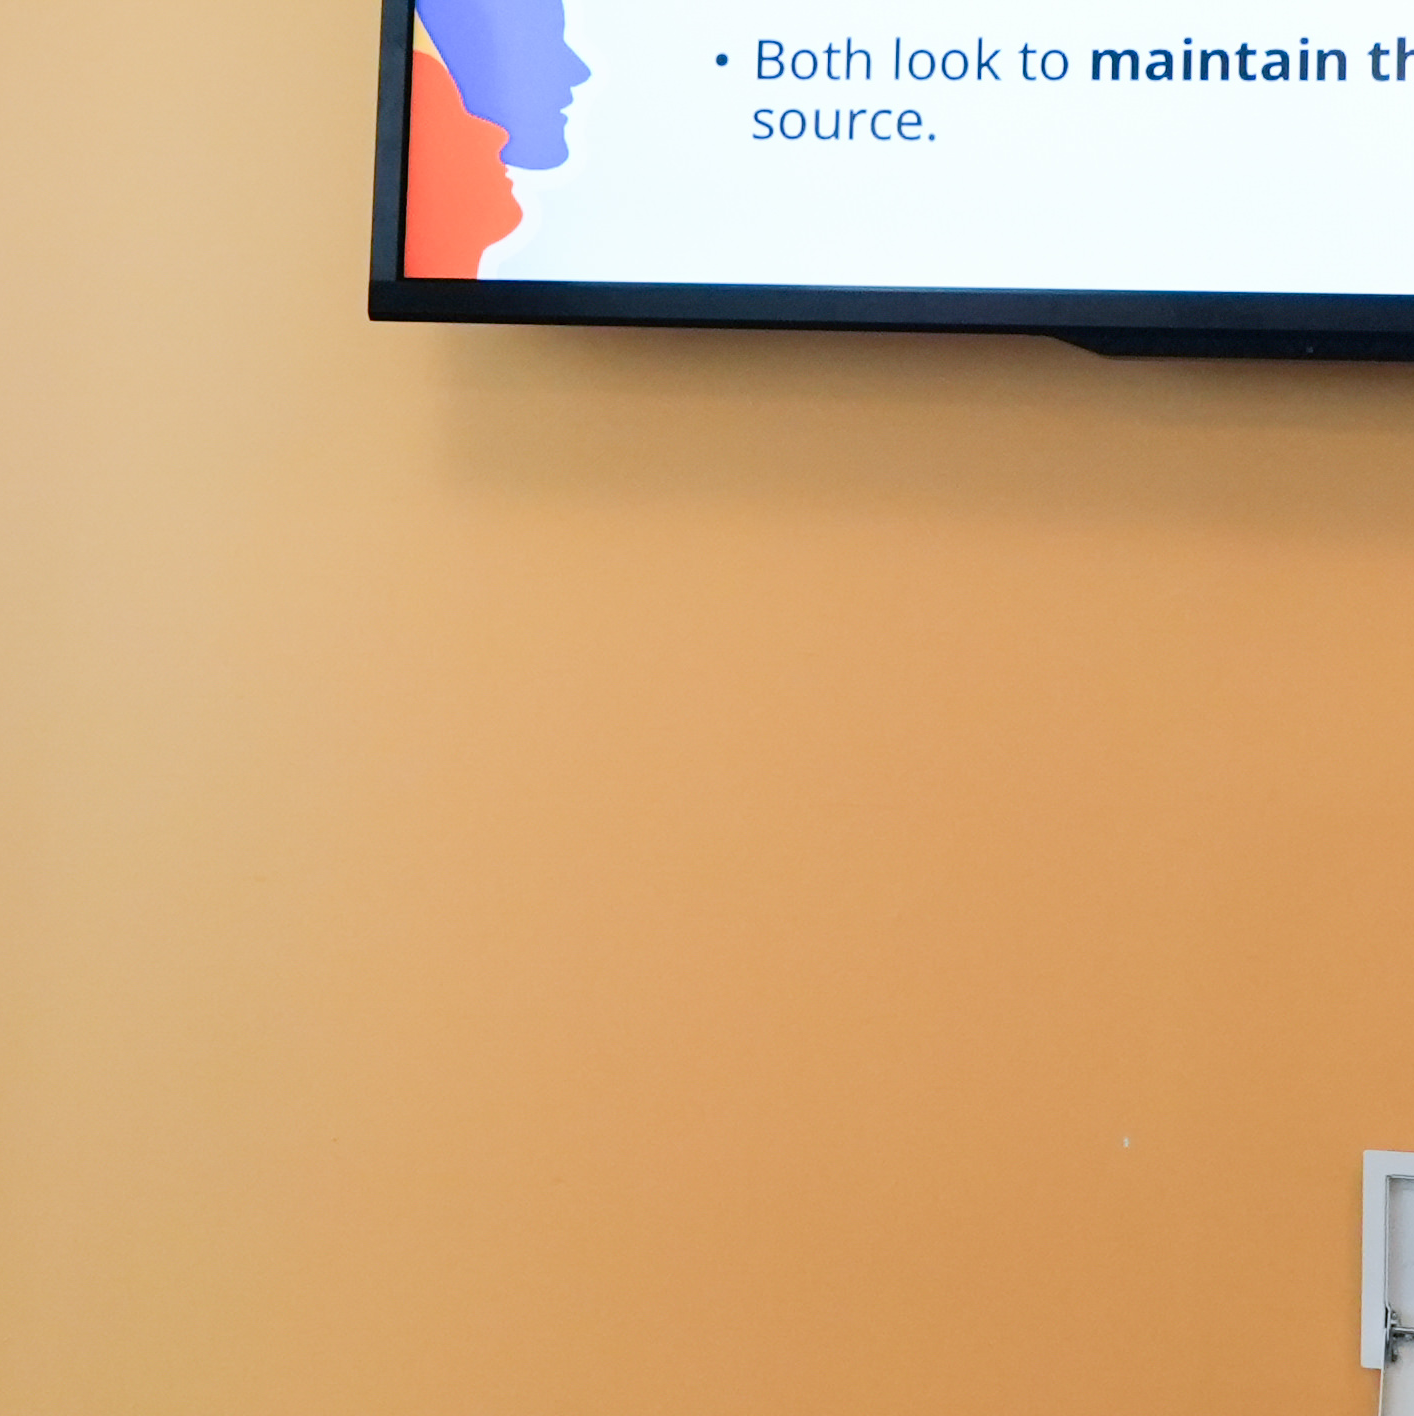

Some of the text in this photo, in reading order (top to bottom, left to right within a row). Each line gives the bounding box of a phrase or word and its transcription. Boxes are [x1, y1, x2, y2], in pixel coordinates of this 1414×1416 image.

[757, 38, 873, 80] Both
[894, 38, 1001, 80] look
[1019, 40, 1069, 80] to
[1091, 38, 1347, 82] maintain
[752, 106, 936, 142] source.
